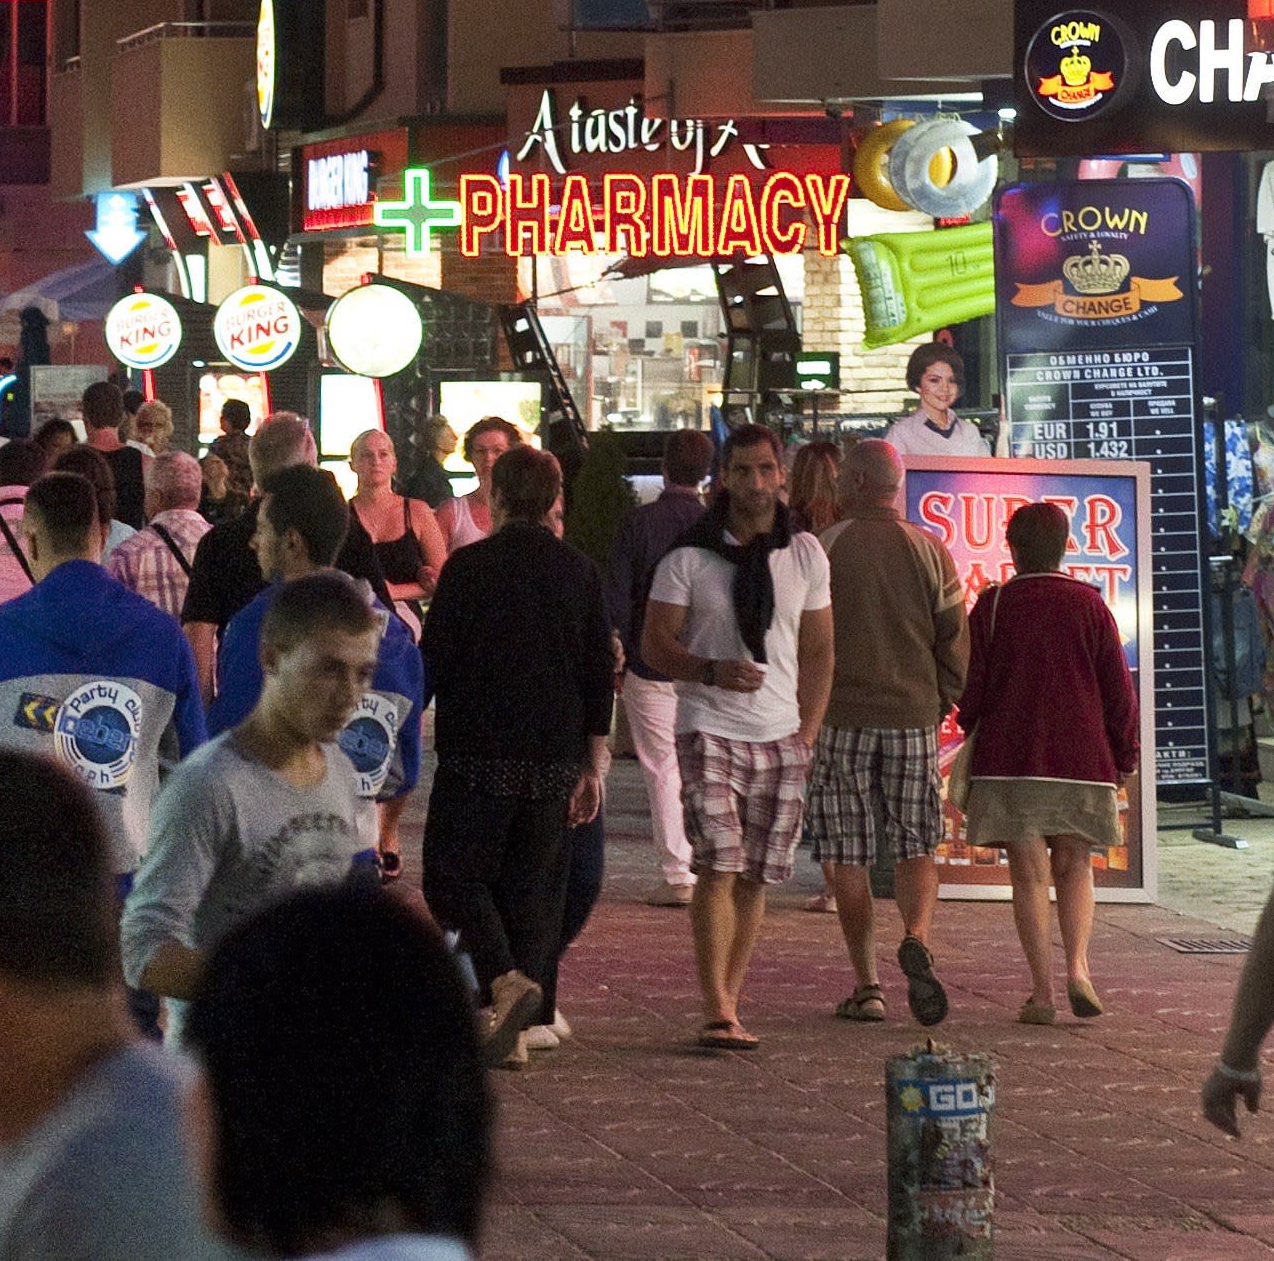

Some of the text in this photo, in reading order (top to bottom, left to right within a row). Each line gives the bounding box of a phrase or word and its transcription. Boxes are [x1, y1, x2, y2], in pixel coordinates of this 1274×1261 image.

[1050, 20, 1101, 46] CROWN
[517, 89, 568, 174] A
[460, 171, 851, 258] PHARMACY
[1041, 205, 1148, 237] CROWN
[226, 300, 286, 331] BURGER
[1062, 296, 1134, 316] CHANGE
[121, 320, 172, 350] KING
[230, 315, 290, 351] KING
[1036, 366, 1164, 381] CROWN CHANGE LTD.
[1050, 351, 1149, 366] ОБМЕННО БЮРО
[1034, 421, 1119, 441] EUR 1.91
[1034, 440, 1129, 459] USD 1.432
[69, 684, 119, 714] Party
